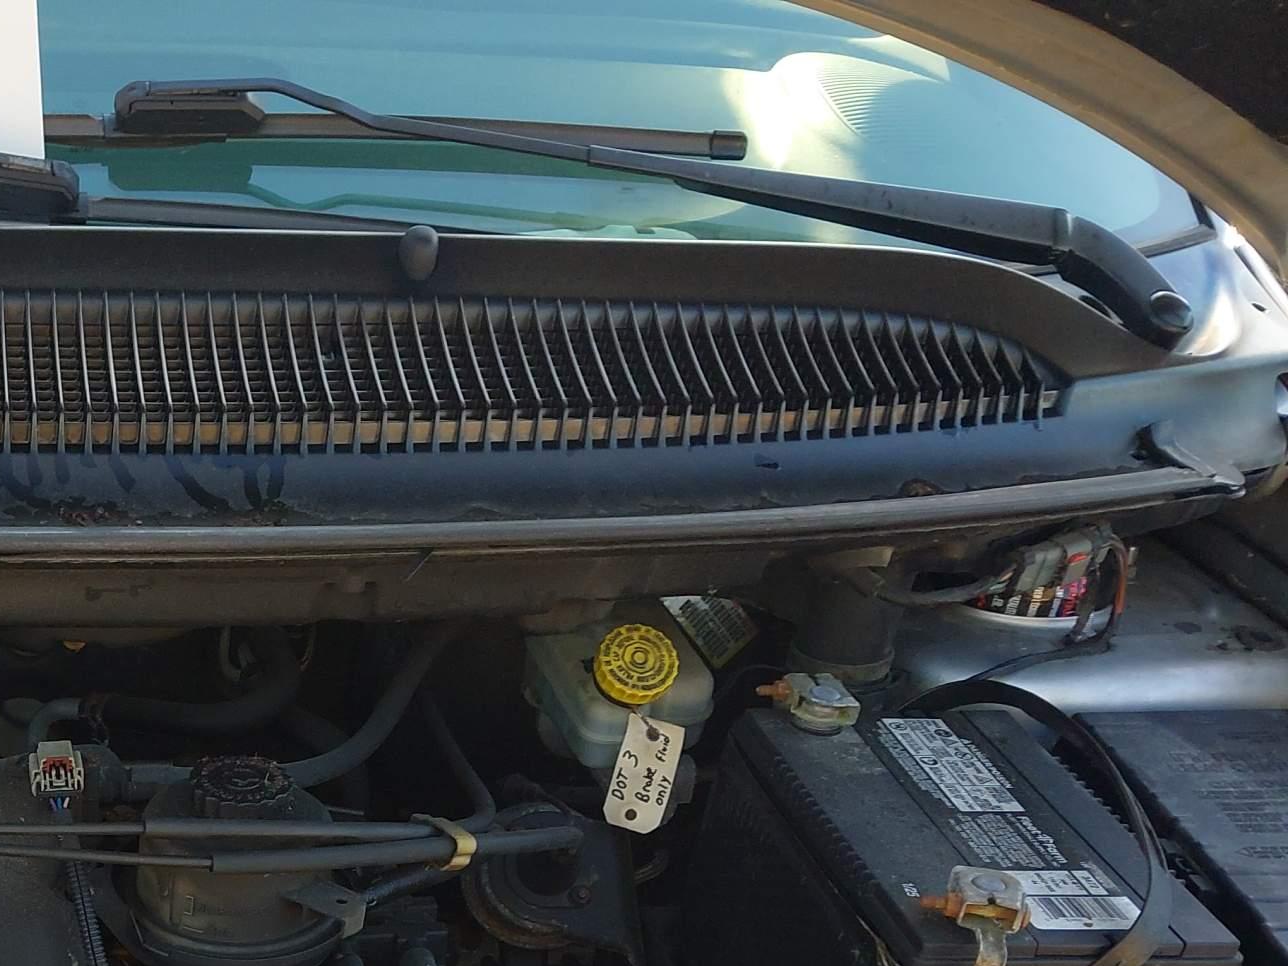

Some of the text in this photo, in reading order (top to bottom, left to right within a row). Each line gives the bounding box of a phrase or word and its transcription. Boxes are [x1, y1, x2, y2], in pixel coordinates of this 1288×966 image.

[612, 750, 638, 800] DOT 3
[634, 767, 658, 803] Brake
[656, 776, 672, 806] only
